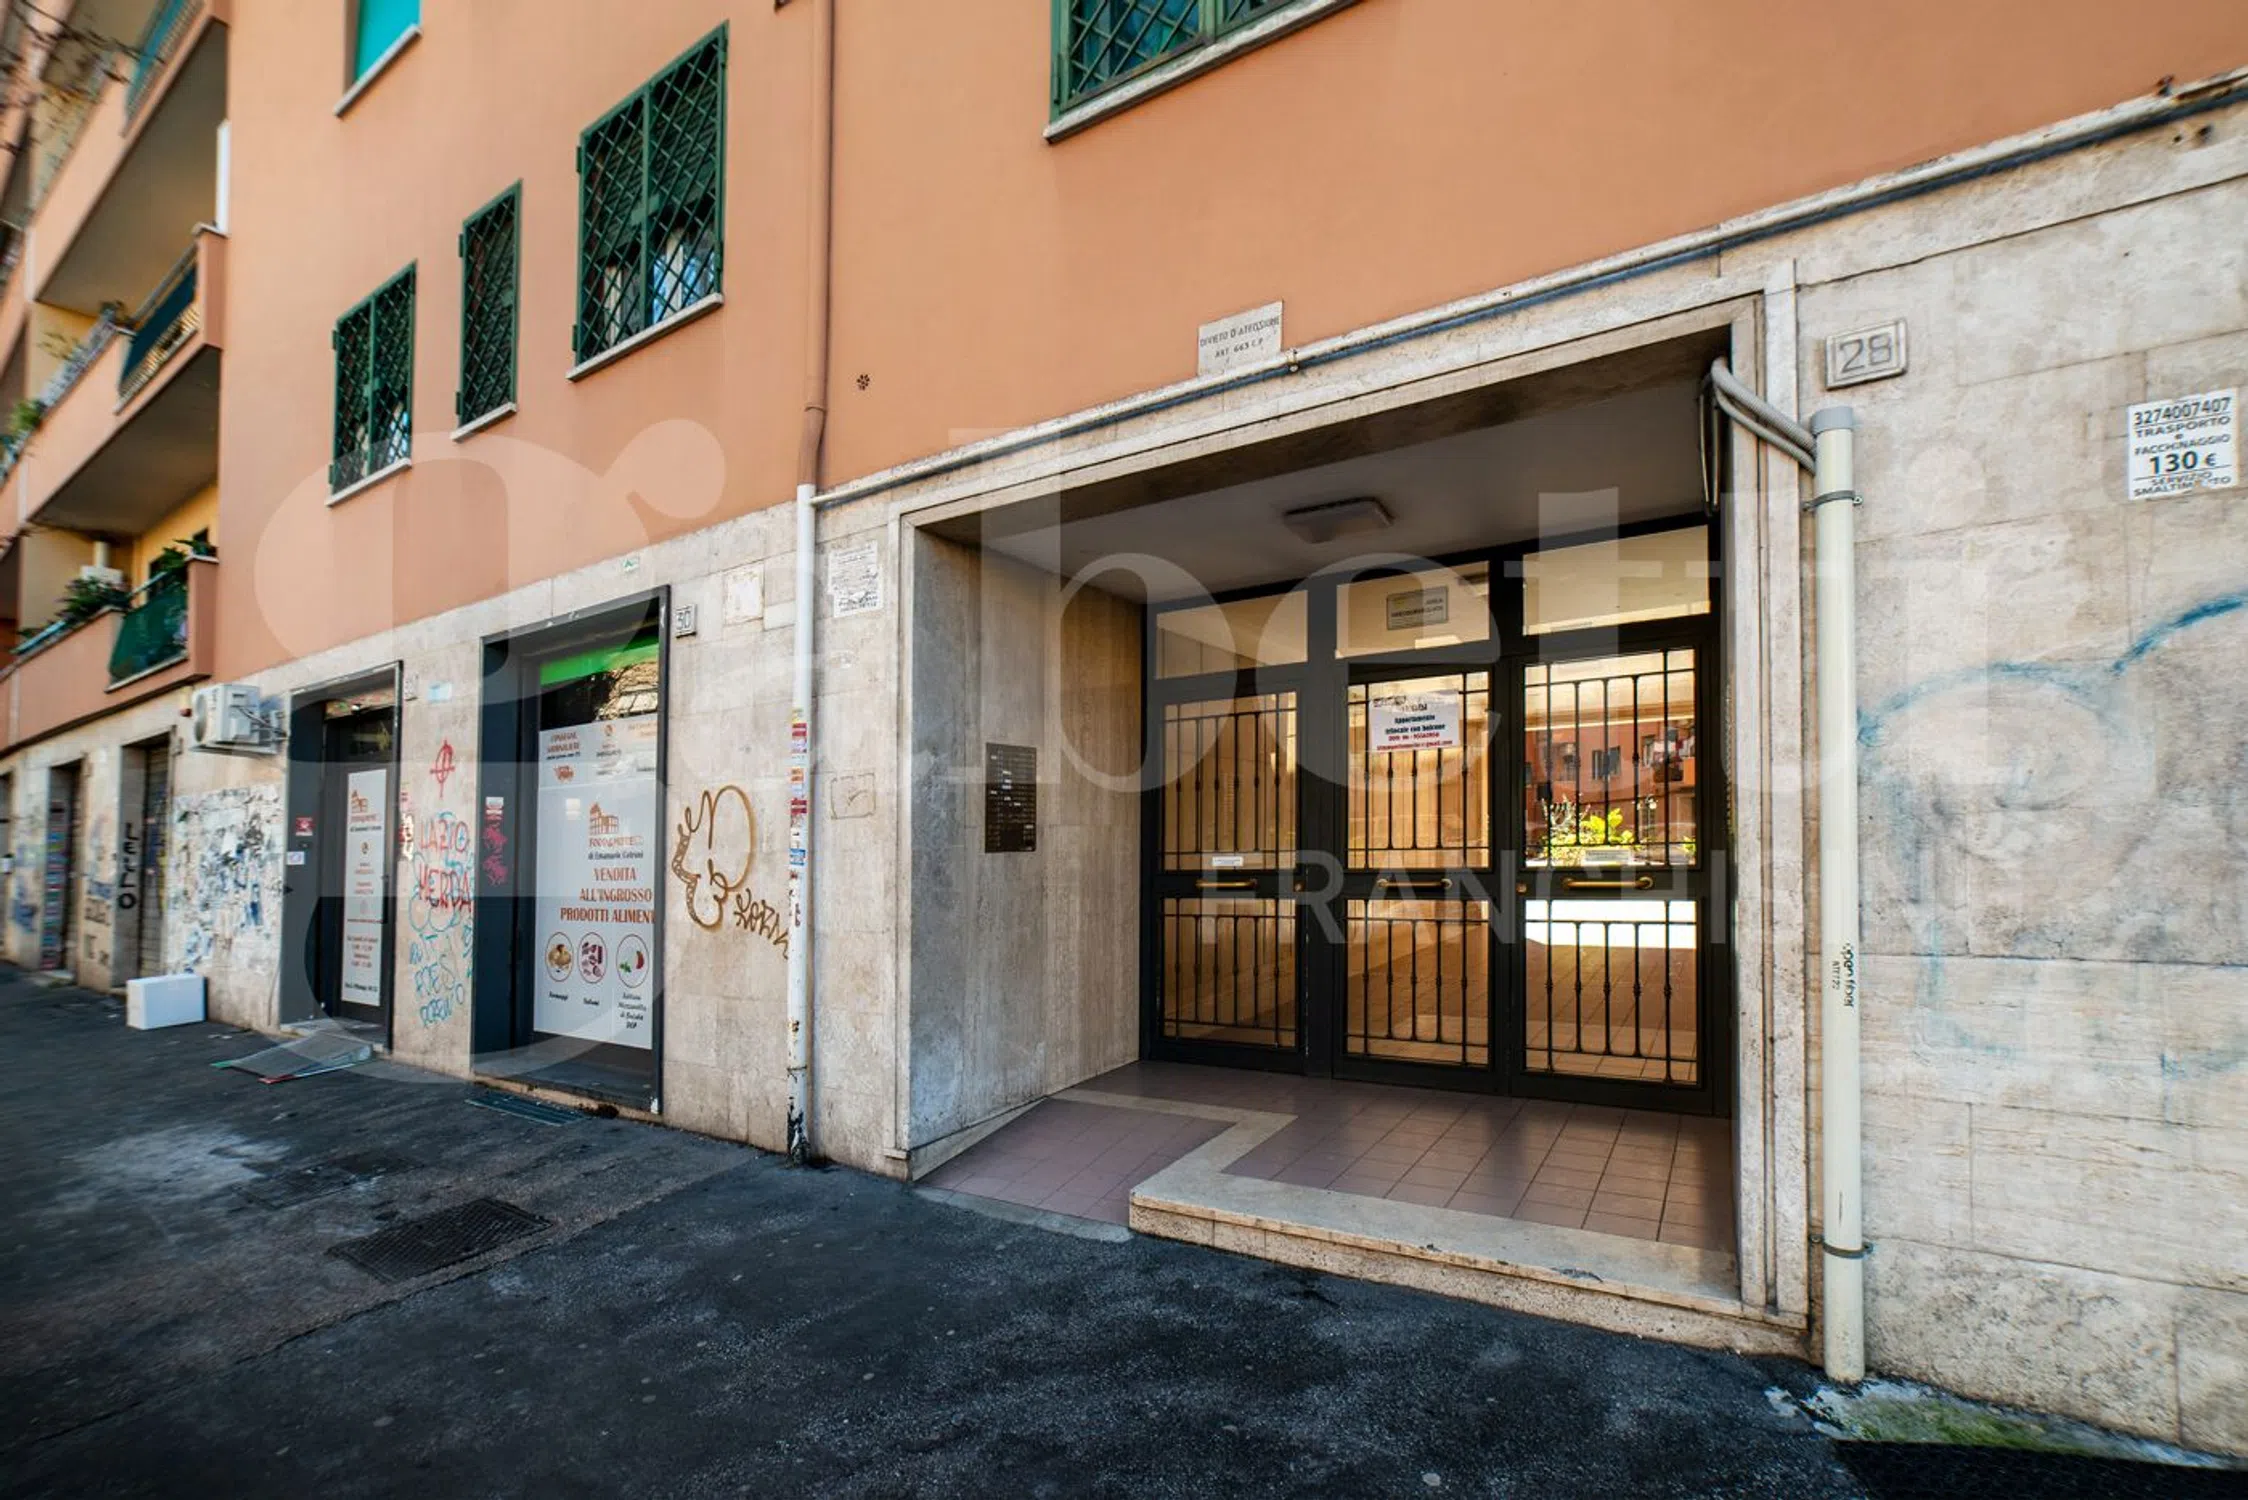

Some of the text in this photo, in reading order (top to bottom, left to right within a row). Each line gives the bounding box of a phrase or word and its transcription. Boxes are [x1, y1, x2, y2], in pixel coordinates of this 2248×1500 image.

[1838, 331, 1893, 374] 28
[2134, 396, 2231, 426] 3274007407
[2136, 415, 2231, 438] TRASPORTO
[2135, 433, 2231, 456] FACCHINAGGIO
[2149, 450, 2217, 474] 130 €
[2134, 475, 2231, 497] SMALTIMTO
[2151, 471, 2212, 486] SERVIZIO
[676, 608, 692, 631] 30
[593, 866, 637, 881] VENDITA
[580, 887, 652, 902] ALL'INGROSSO
[560, 906, 609, 922] PRODOTTI
